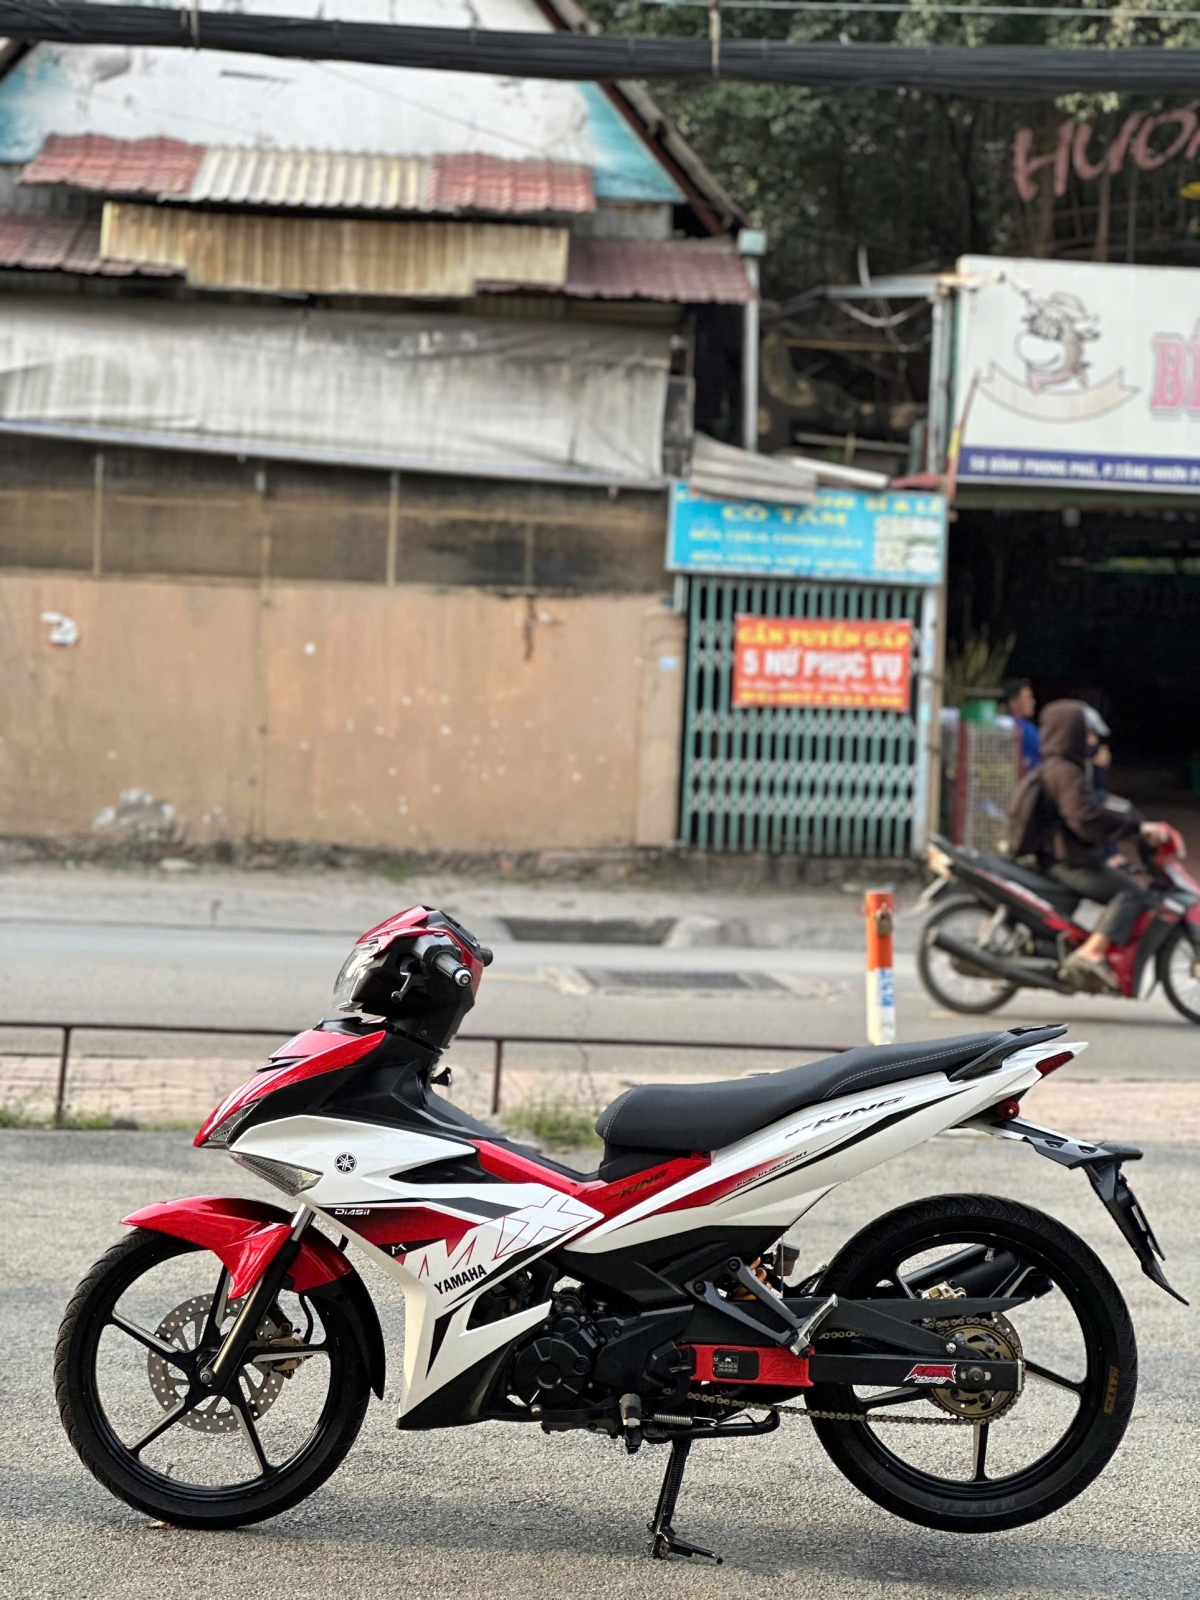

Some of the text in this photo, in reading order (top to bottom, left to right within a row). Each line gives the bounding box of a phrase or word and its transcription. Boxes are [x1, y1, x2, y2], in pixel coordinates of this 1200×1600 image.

[742, 649, 759, 676] 5
[803, 651, 867, 682] PHỤC
[870, 653, 904, 685] VỤ
[812, 1095, 907, 1131] KING
[434, 1264, 487, 1296] YAMAHA
